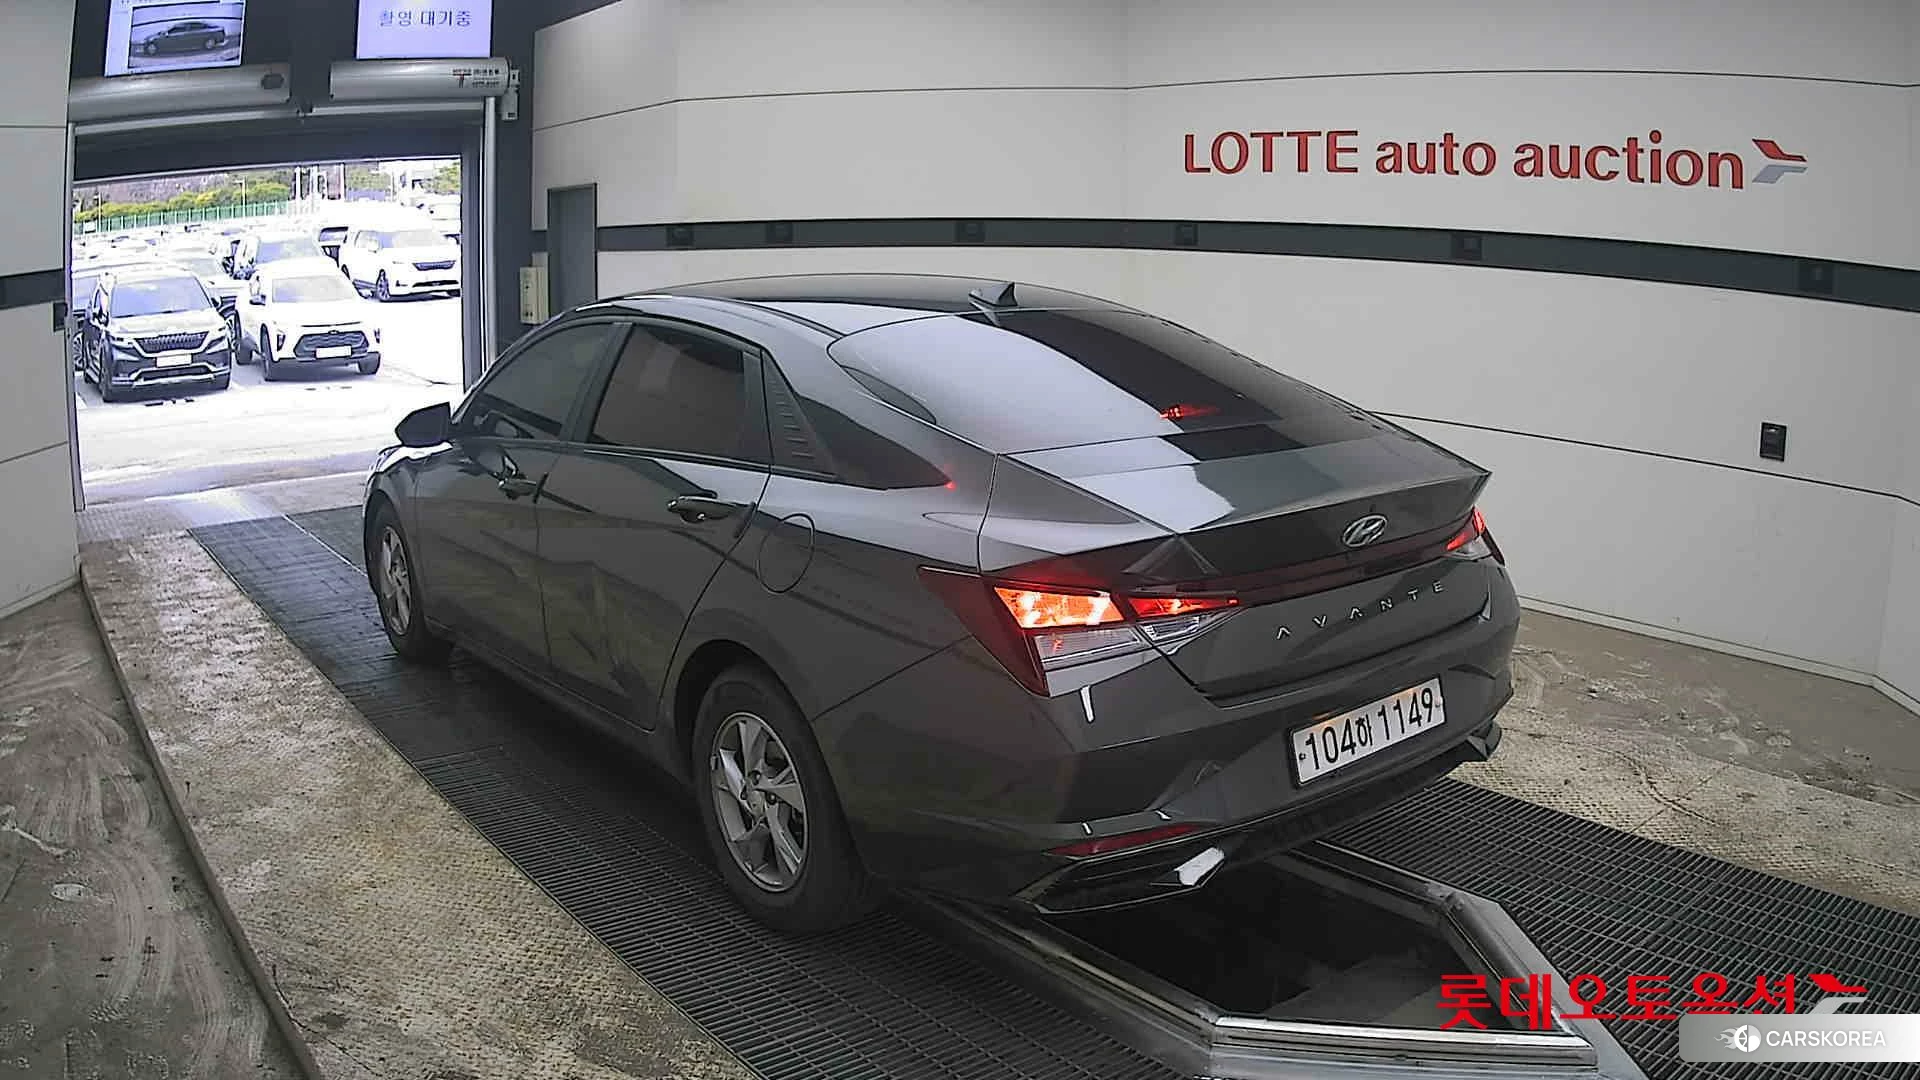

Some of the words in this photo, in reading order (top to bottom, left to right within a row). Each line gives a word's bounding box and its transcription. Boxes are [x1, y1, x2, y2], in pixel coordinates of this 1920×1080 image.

[420, 10, 472, 27] 대기중
[1184, 130, 1359, 174] LOTTE
[1375, 132, 1497, 176] auto
[1513, 130, 1744, 189] auction
[1275, 580, 1445, 641] AVANTE
[1305, 714, 1373, 770] 104하
[1377, 687, 1434, 740] 1149
